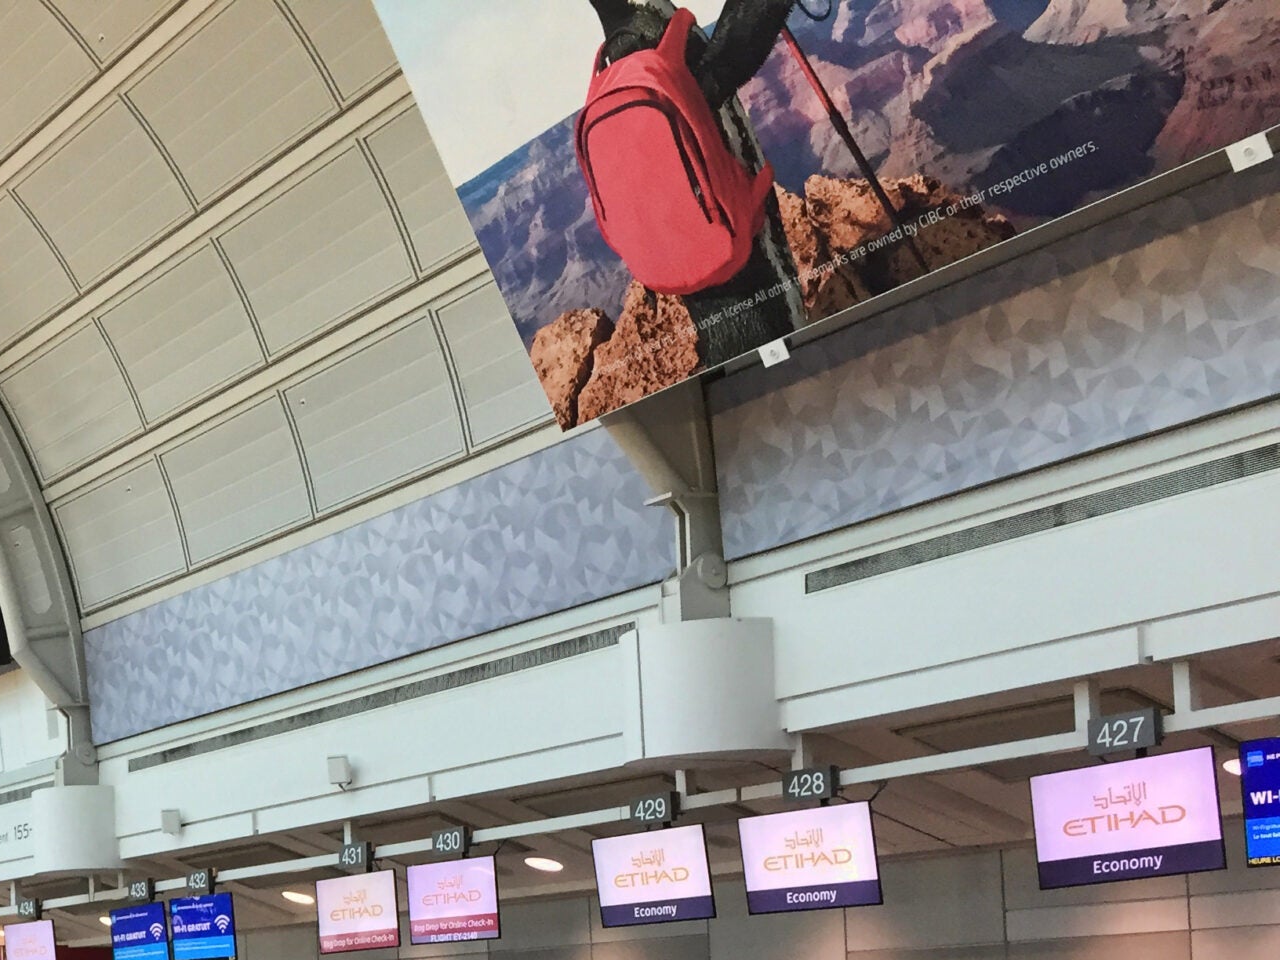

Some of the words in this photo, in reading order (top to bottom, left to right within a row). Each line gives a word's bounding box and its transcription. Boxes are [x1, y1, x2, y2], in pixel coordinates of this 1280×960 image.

[697, 311, 723, 331] under
[769, 279, 792, 298] other
[849, 246, 867, 260] are
[867, 226, 903, 251] owned
[904, 222, 918, 238] by
[918, 207, 945, 228] CIBC
[946, 203, 959, 217] or
[959, 189, 986, 211] their
[988, 162, 1048, 196] respective
[1050, 139, 1101, 169] owners.
[1097, 716, 1145, 748] 427
[788, 773, 825, 797] 428
[634, 798, 666, 821] 429
[1063, 805, 1186, 836] ETIHAD
[435, 831, 460, 851] 430
[341, 849, 362, 865] 431
[763, 848, 852, 871] ETIHAD
[1093, 855, 1163, 874] Economy
[188, 872, 206, 889] 432
[613, 867, 690, 888] ETIHAD
[130, 882, 146, 897] 433
[422, 889, 482, 906] ETIHAD
[786, 889, 837, 904] Economy
[19, 901, 34, 915] 434
[329, 904, 384, 921] ETIHAD
[634, 904, 677, 918] Economy
